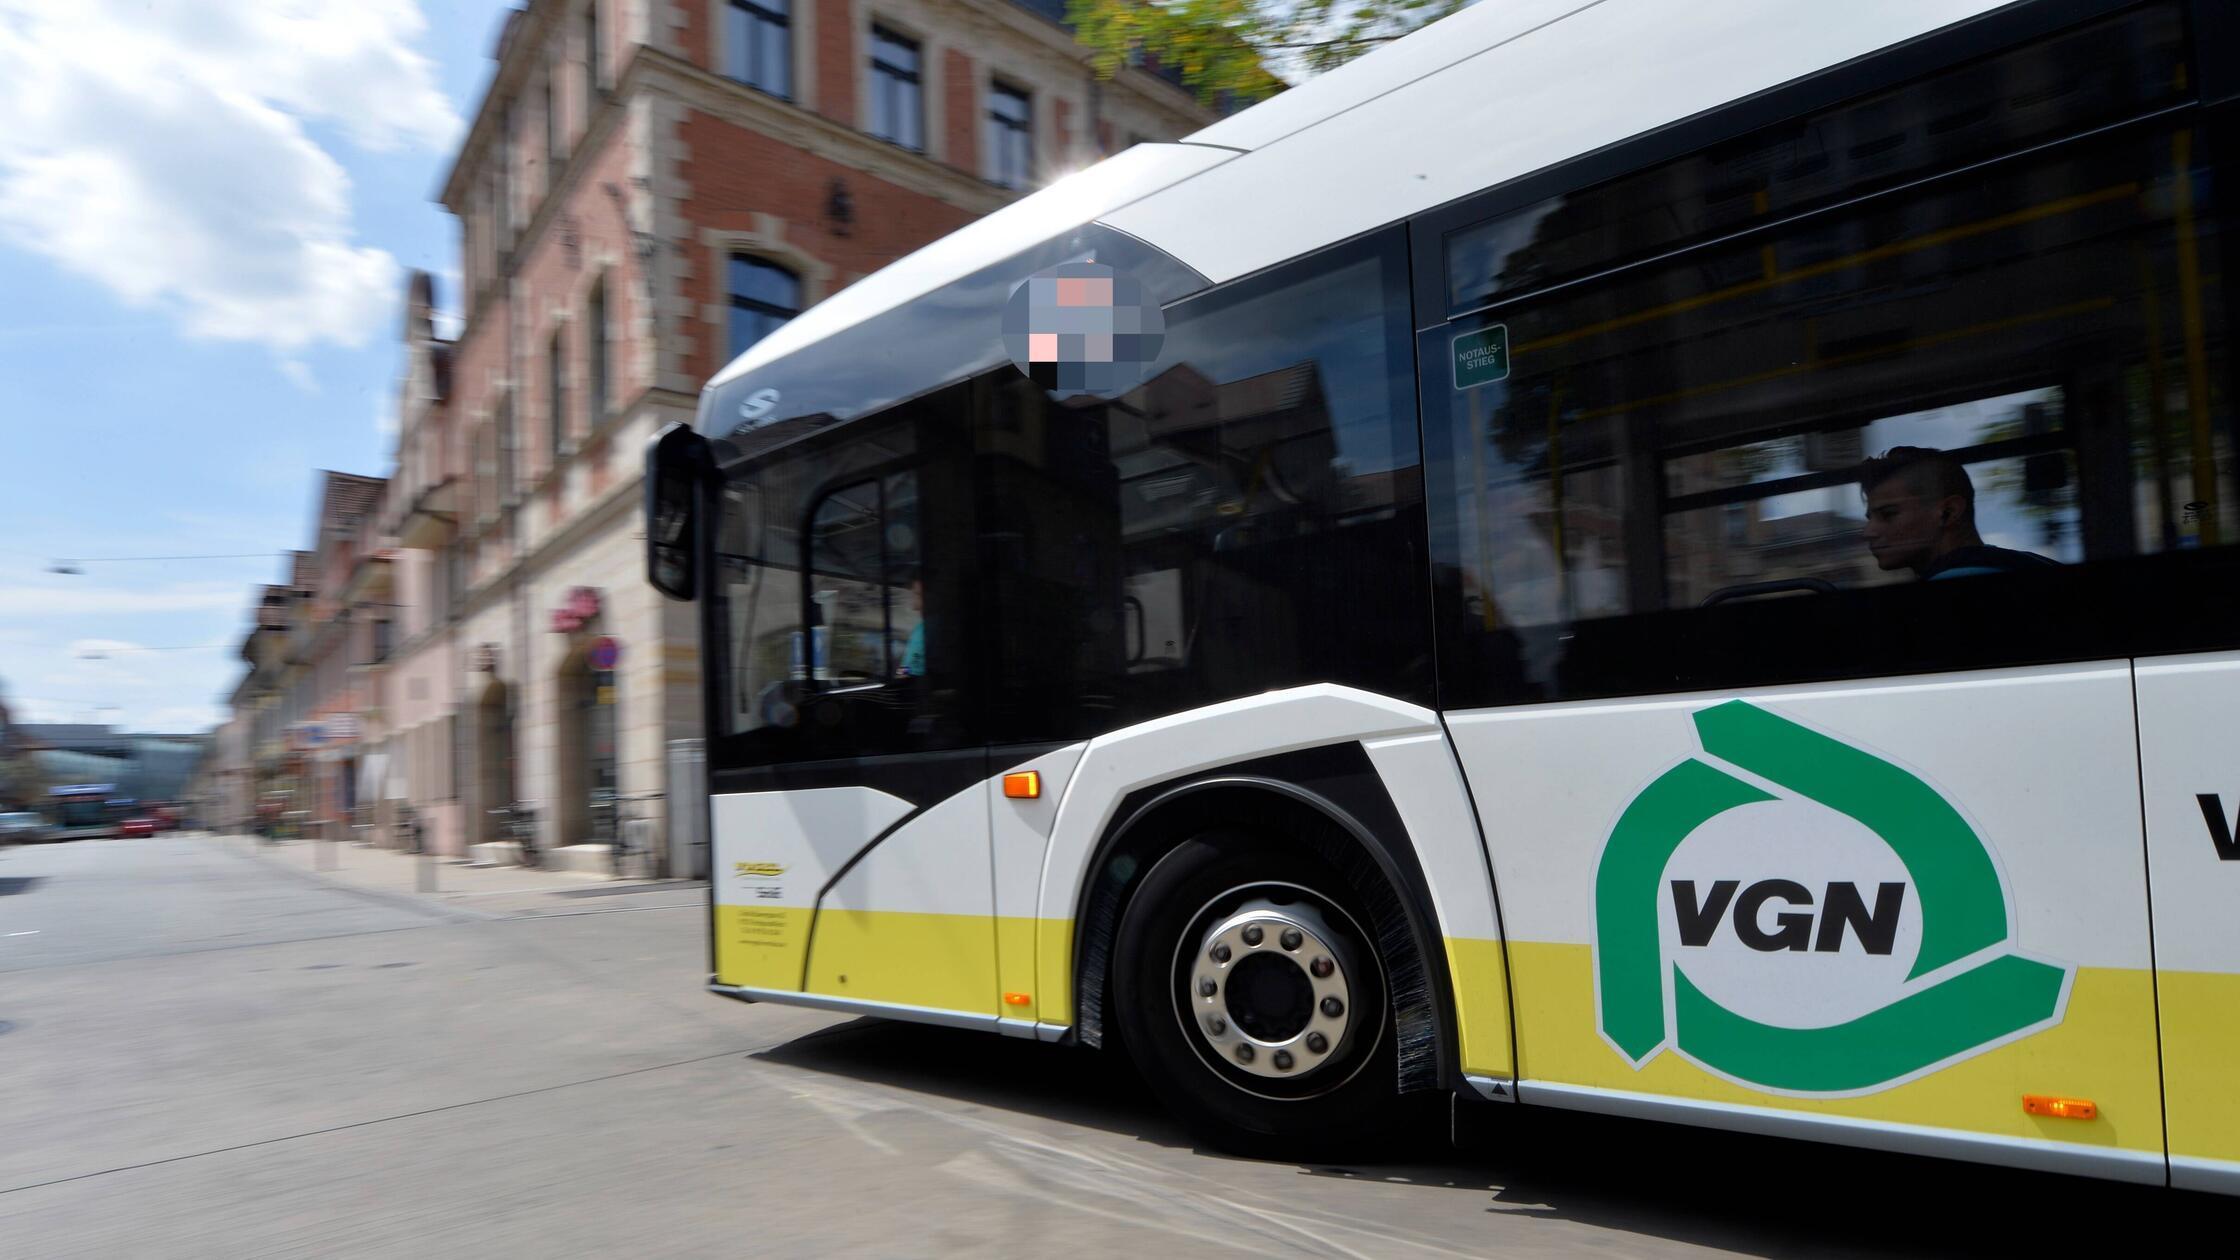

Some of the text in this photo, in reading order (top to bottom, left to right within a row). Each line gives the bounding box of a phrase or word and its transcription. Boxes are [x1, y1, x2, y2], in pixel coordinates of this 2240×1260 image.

[1459, 344, 1502, 362] NOTAUS-
[1466, 354, 1496, 370] STIEG
[1670, 878, 1906, 955] VGN
